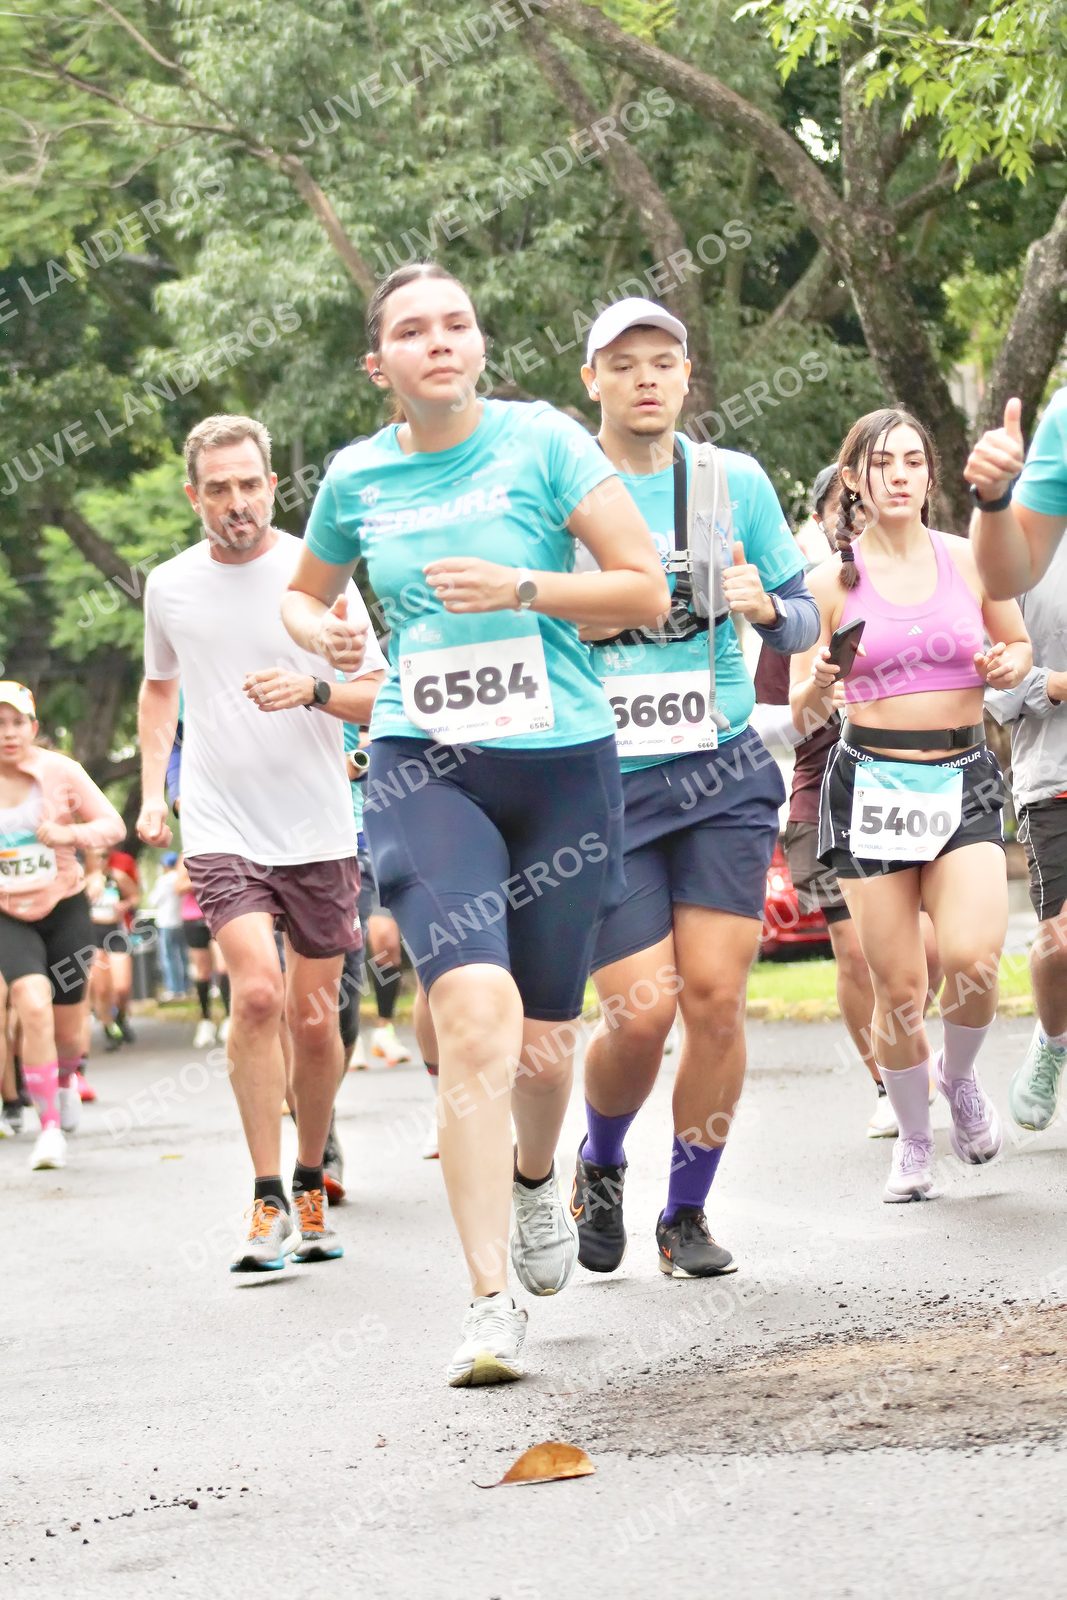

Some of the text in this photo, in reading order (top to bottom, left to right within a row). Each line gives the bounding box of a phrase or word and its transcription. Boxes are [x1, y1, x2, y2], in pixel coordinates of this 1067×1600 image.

[413, 661, 540, 715] 6584
[529, 721, 550, 731] 6584
[608, 690, 707, 730] 6660
[859, 804, 952, 838] 5400
[0, 854, 52, 877] 6734
